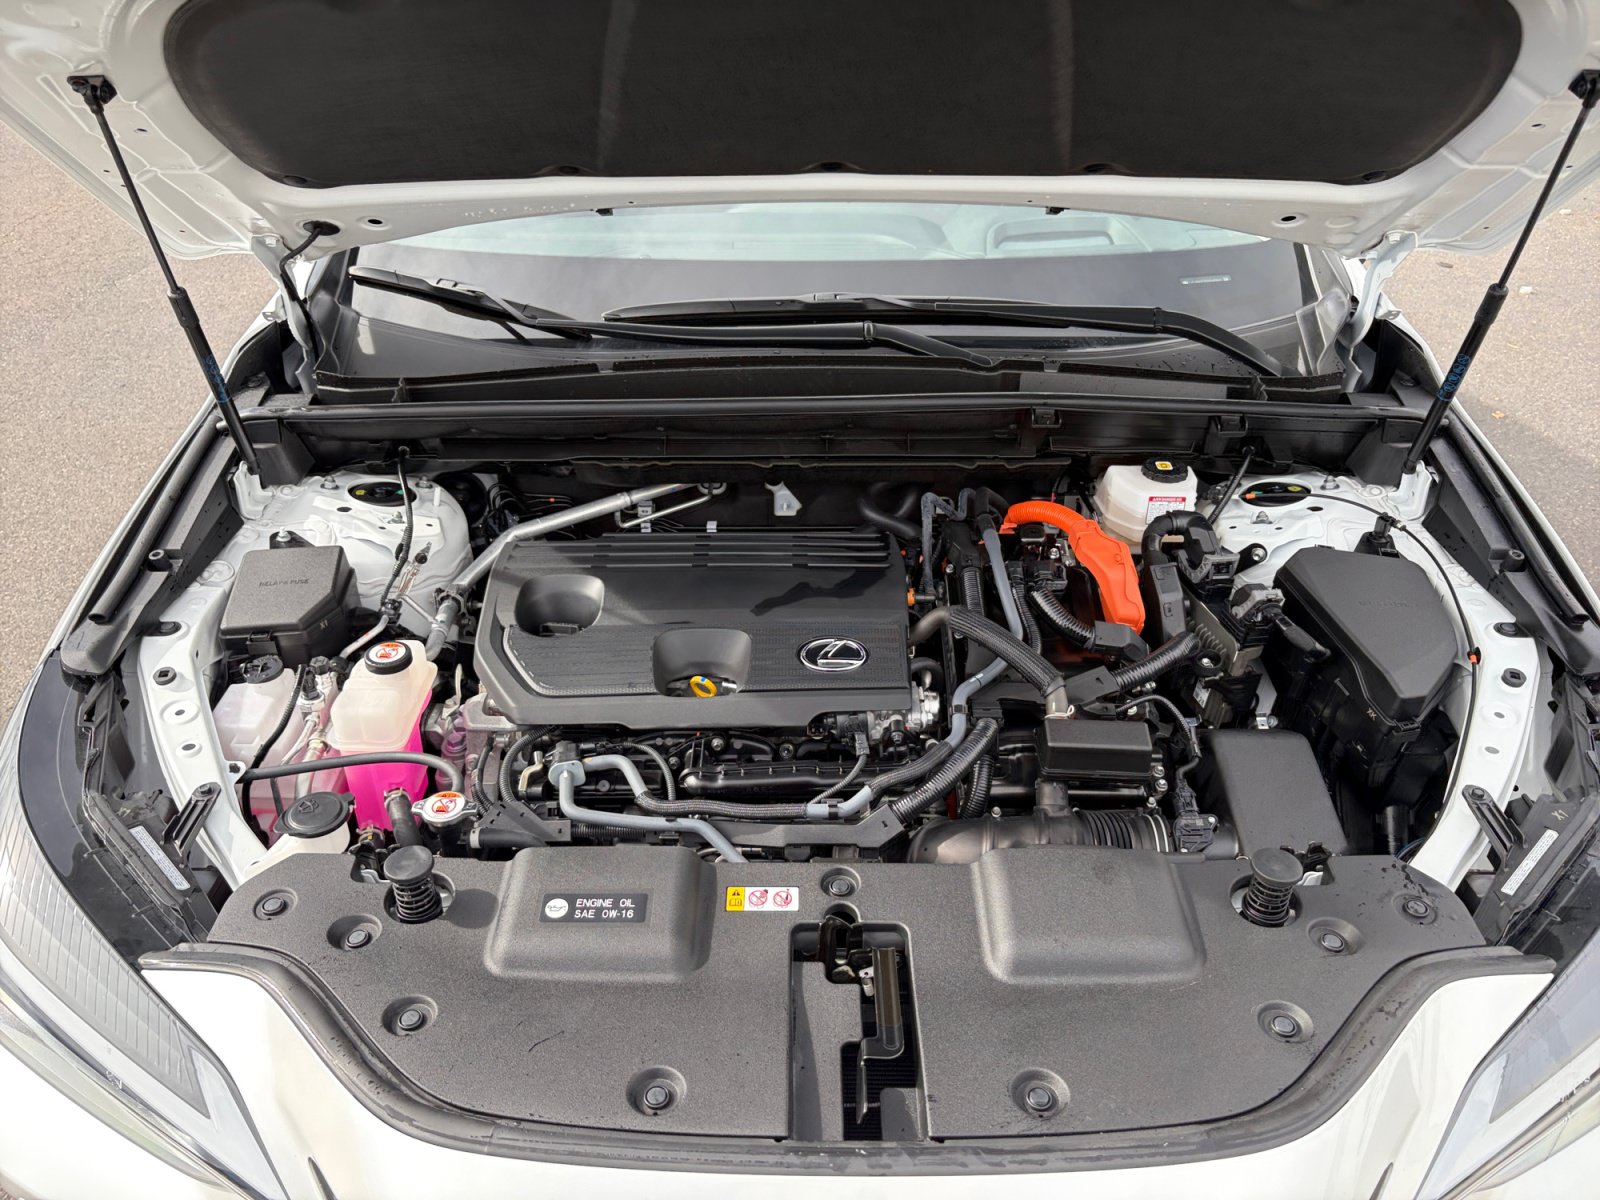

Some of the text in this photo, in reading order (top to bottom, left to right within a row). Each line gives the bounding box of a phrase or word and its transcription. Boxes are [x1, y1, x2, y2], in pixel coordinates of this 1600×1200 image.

[576, 898, 635, 907] ENGINE OIL
[574, 909, 595, 918] SAE
